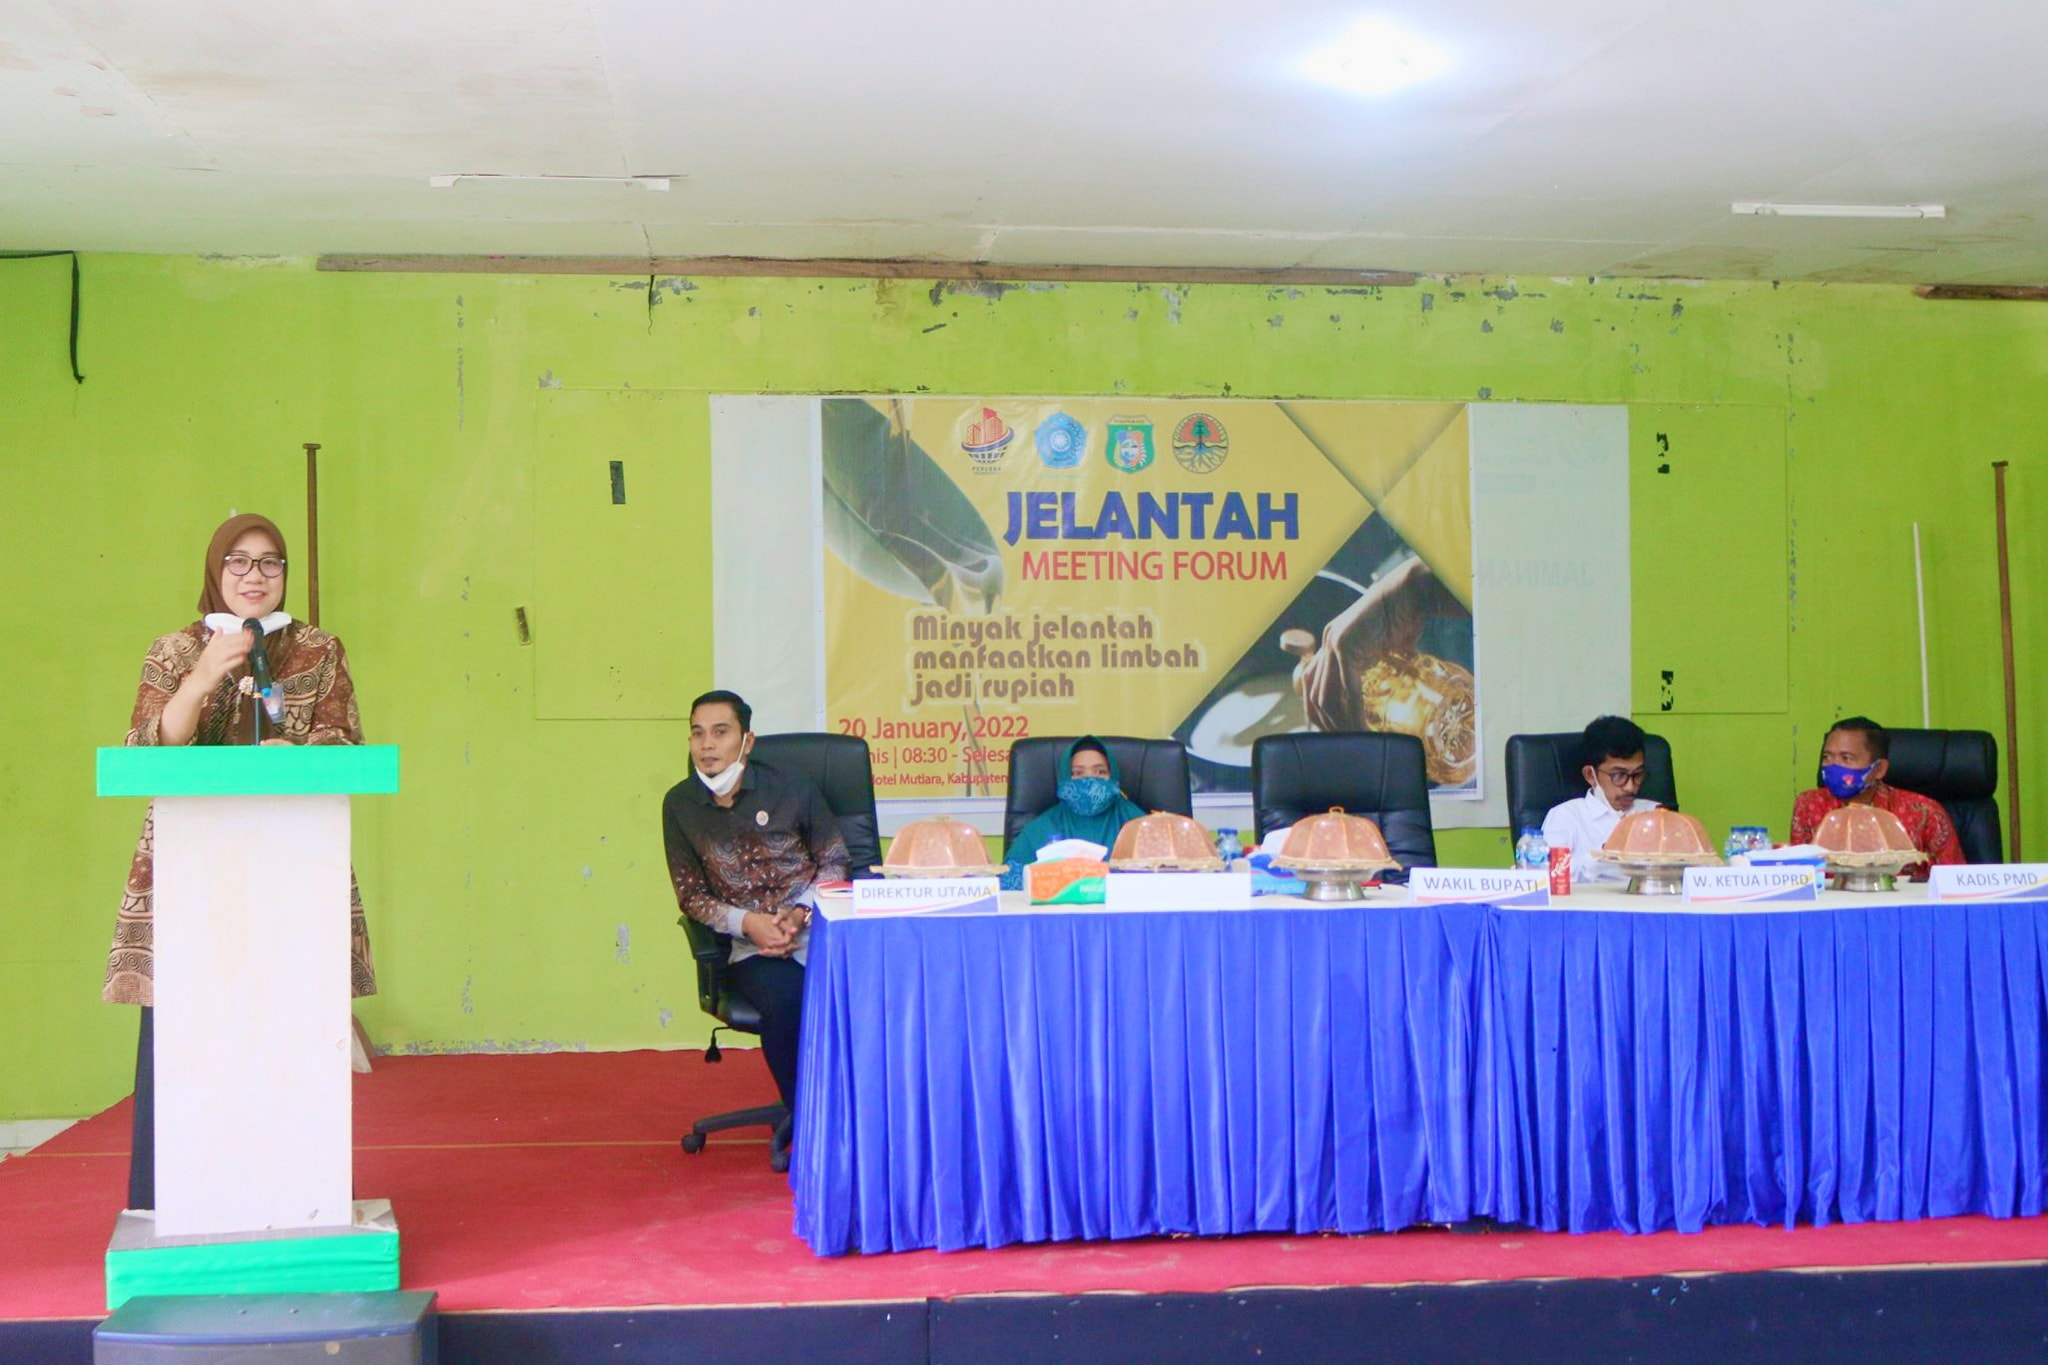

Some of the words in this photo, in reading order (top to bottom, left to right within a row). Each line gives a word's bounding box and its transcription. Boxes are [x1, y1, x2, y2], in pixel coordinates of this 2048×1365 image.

[1003, 491, 1299, 547] JELANTAH
[1021, 551, 1164, 581] MEETING
[1173, 551, 1288, 581] FORUM
[913, 614, 1023, 648] Minyak
[1028, 614, 1153, 646] jelantah
[913, 644, 1091, 669] manfaatkan
[1101, 643, 1199, 668] limbah
[910, 673, 972, 706] jadi
[982, 672, 1075, 704] rupiah
[839, 718, 867, 739] 20
[872, 716, 968, 744] January,
[973, 715, 1029, 738] 2022
[902, 747, 947, 764] 08:30
[900, 773, 945, 785] Mutiara,
[947, 773, 1010, 787] Kabupaten
[1423, 877, 1476, 890] WAKIL
[1480, 878, 1539, 892] BUPATI
[1693, 875, 1712, 888] W.
[1716, 874, 1760, 887] KETUA
[1764, 874, 1768, 886] I
[1772, 874, 1809, 886] DPRD
[1956, 873, 2000, 886] KADIS
[2003, 872, 2038, 885] PMD
[861, 886, 933, 899] DIREKTUR
[937, 885, 992, 898] UTAMA
